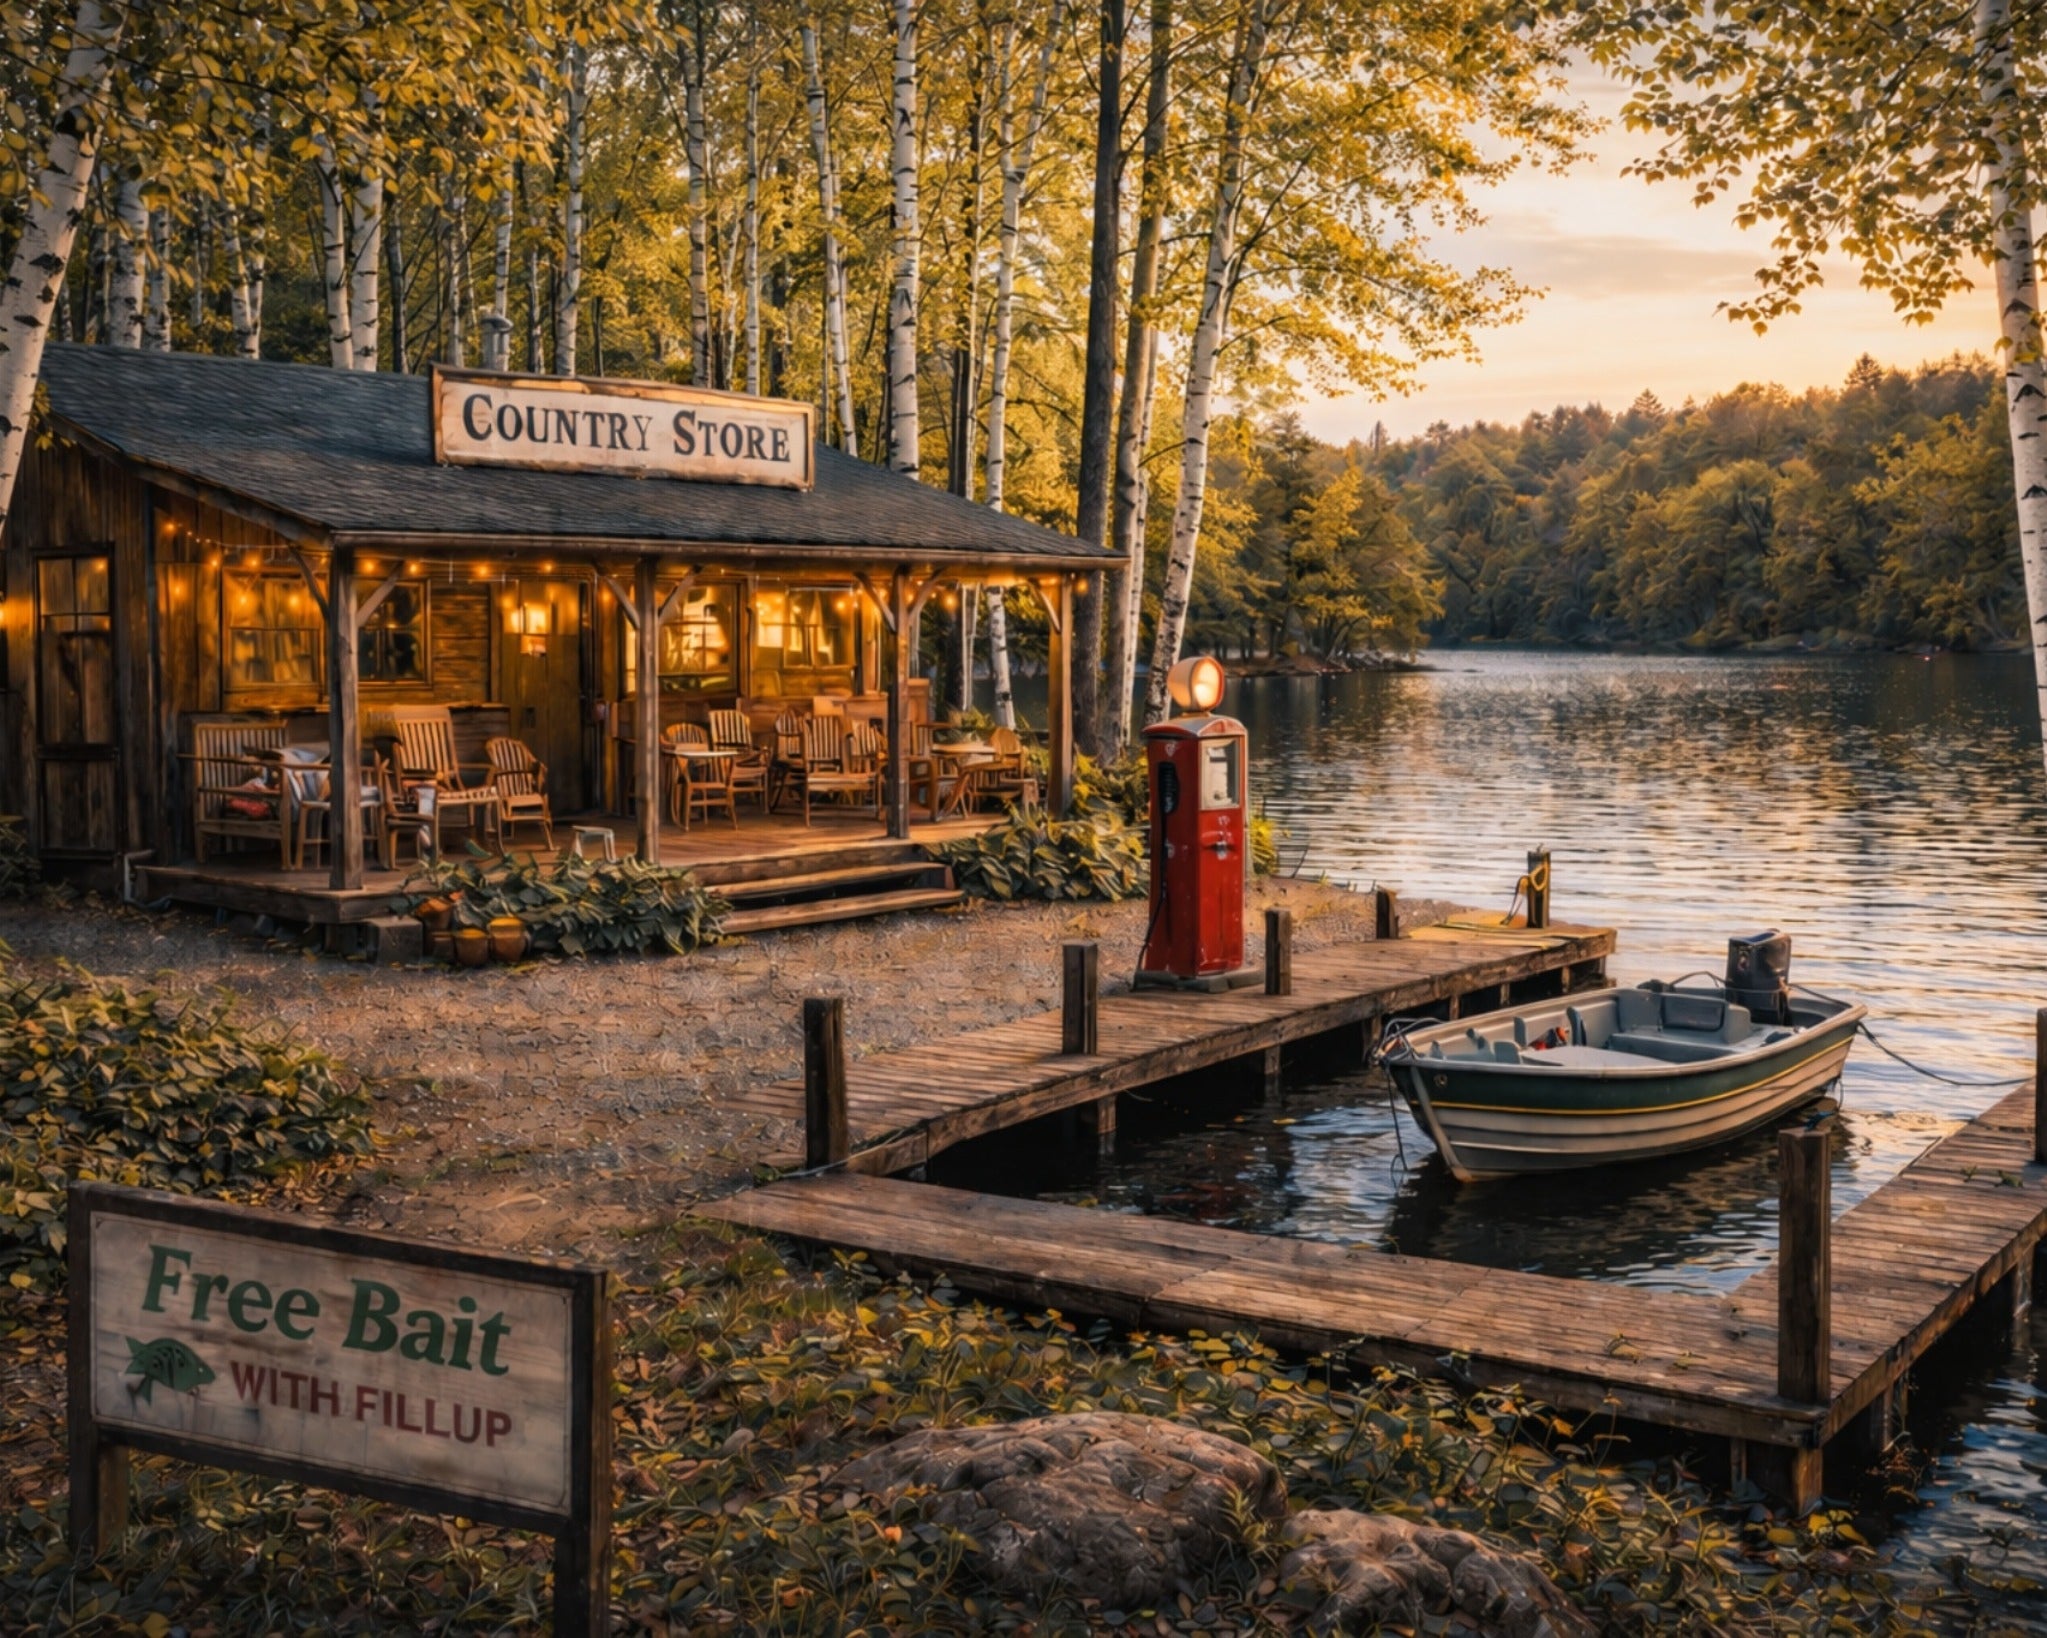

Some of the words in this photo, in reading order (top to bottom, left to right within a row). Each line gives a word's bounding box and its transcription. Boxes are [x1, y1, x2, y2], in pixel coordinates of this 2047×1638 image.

[463, 394, 653, 451] COUNTRY
[673, 409, 791, 463] STORE
[141, 1244, 321, 1341] Free
[342, 1278, 510, 1376] Bait
[230, 1361, 340, 1418] WITH
[355, 1384, 513, 1448] FILLUP
